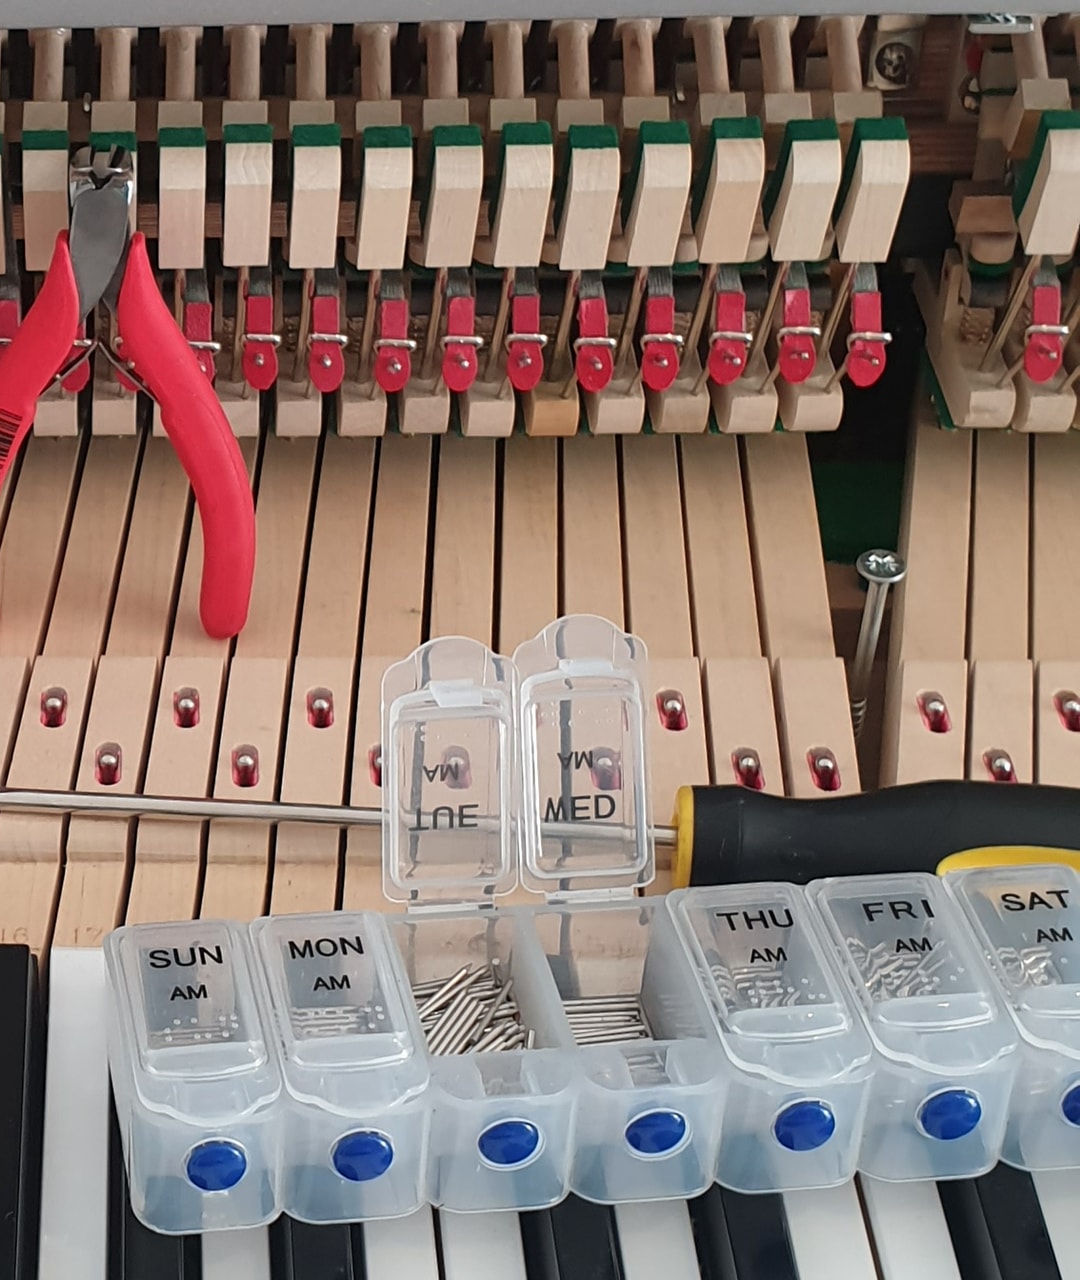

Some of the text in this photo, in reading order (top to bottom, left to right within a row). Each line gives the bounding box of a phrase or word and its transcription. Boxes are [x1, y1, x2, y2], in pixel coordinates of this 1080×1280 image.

[862, 898, 936, 922] FRI
[1000, 888, 1071, 912] SAT
[716, 907, 795, 932] THU
[894, 936, 933, 954] AM
[1035, 926, 1074, 944] AM
[148, 944, 224, 969] SUN
[286, 935, 365, 961] MON
[749, 946, 788, 964] AM
[169, 983, 209, 1001] AM
[312, 973, 351, 992] AM
